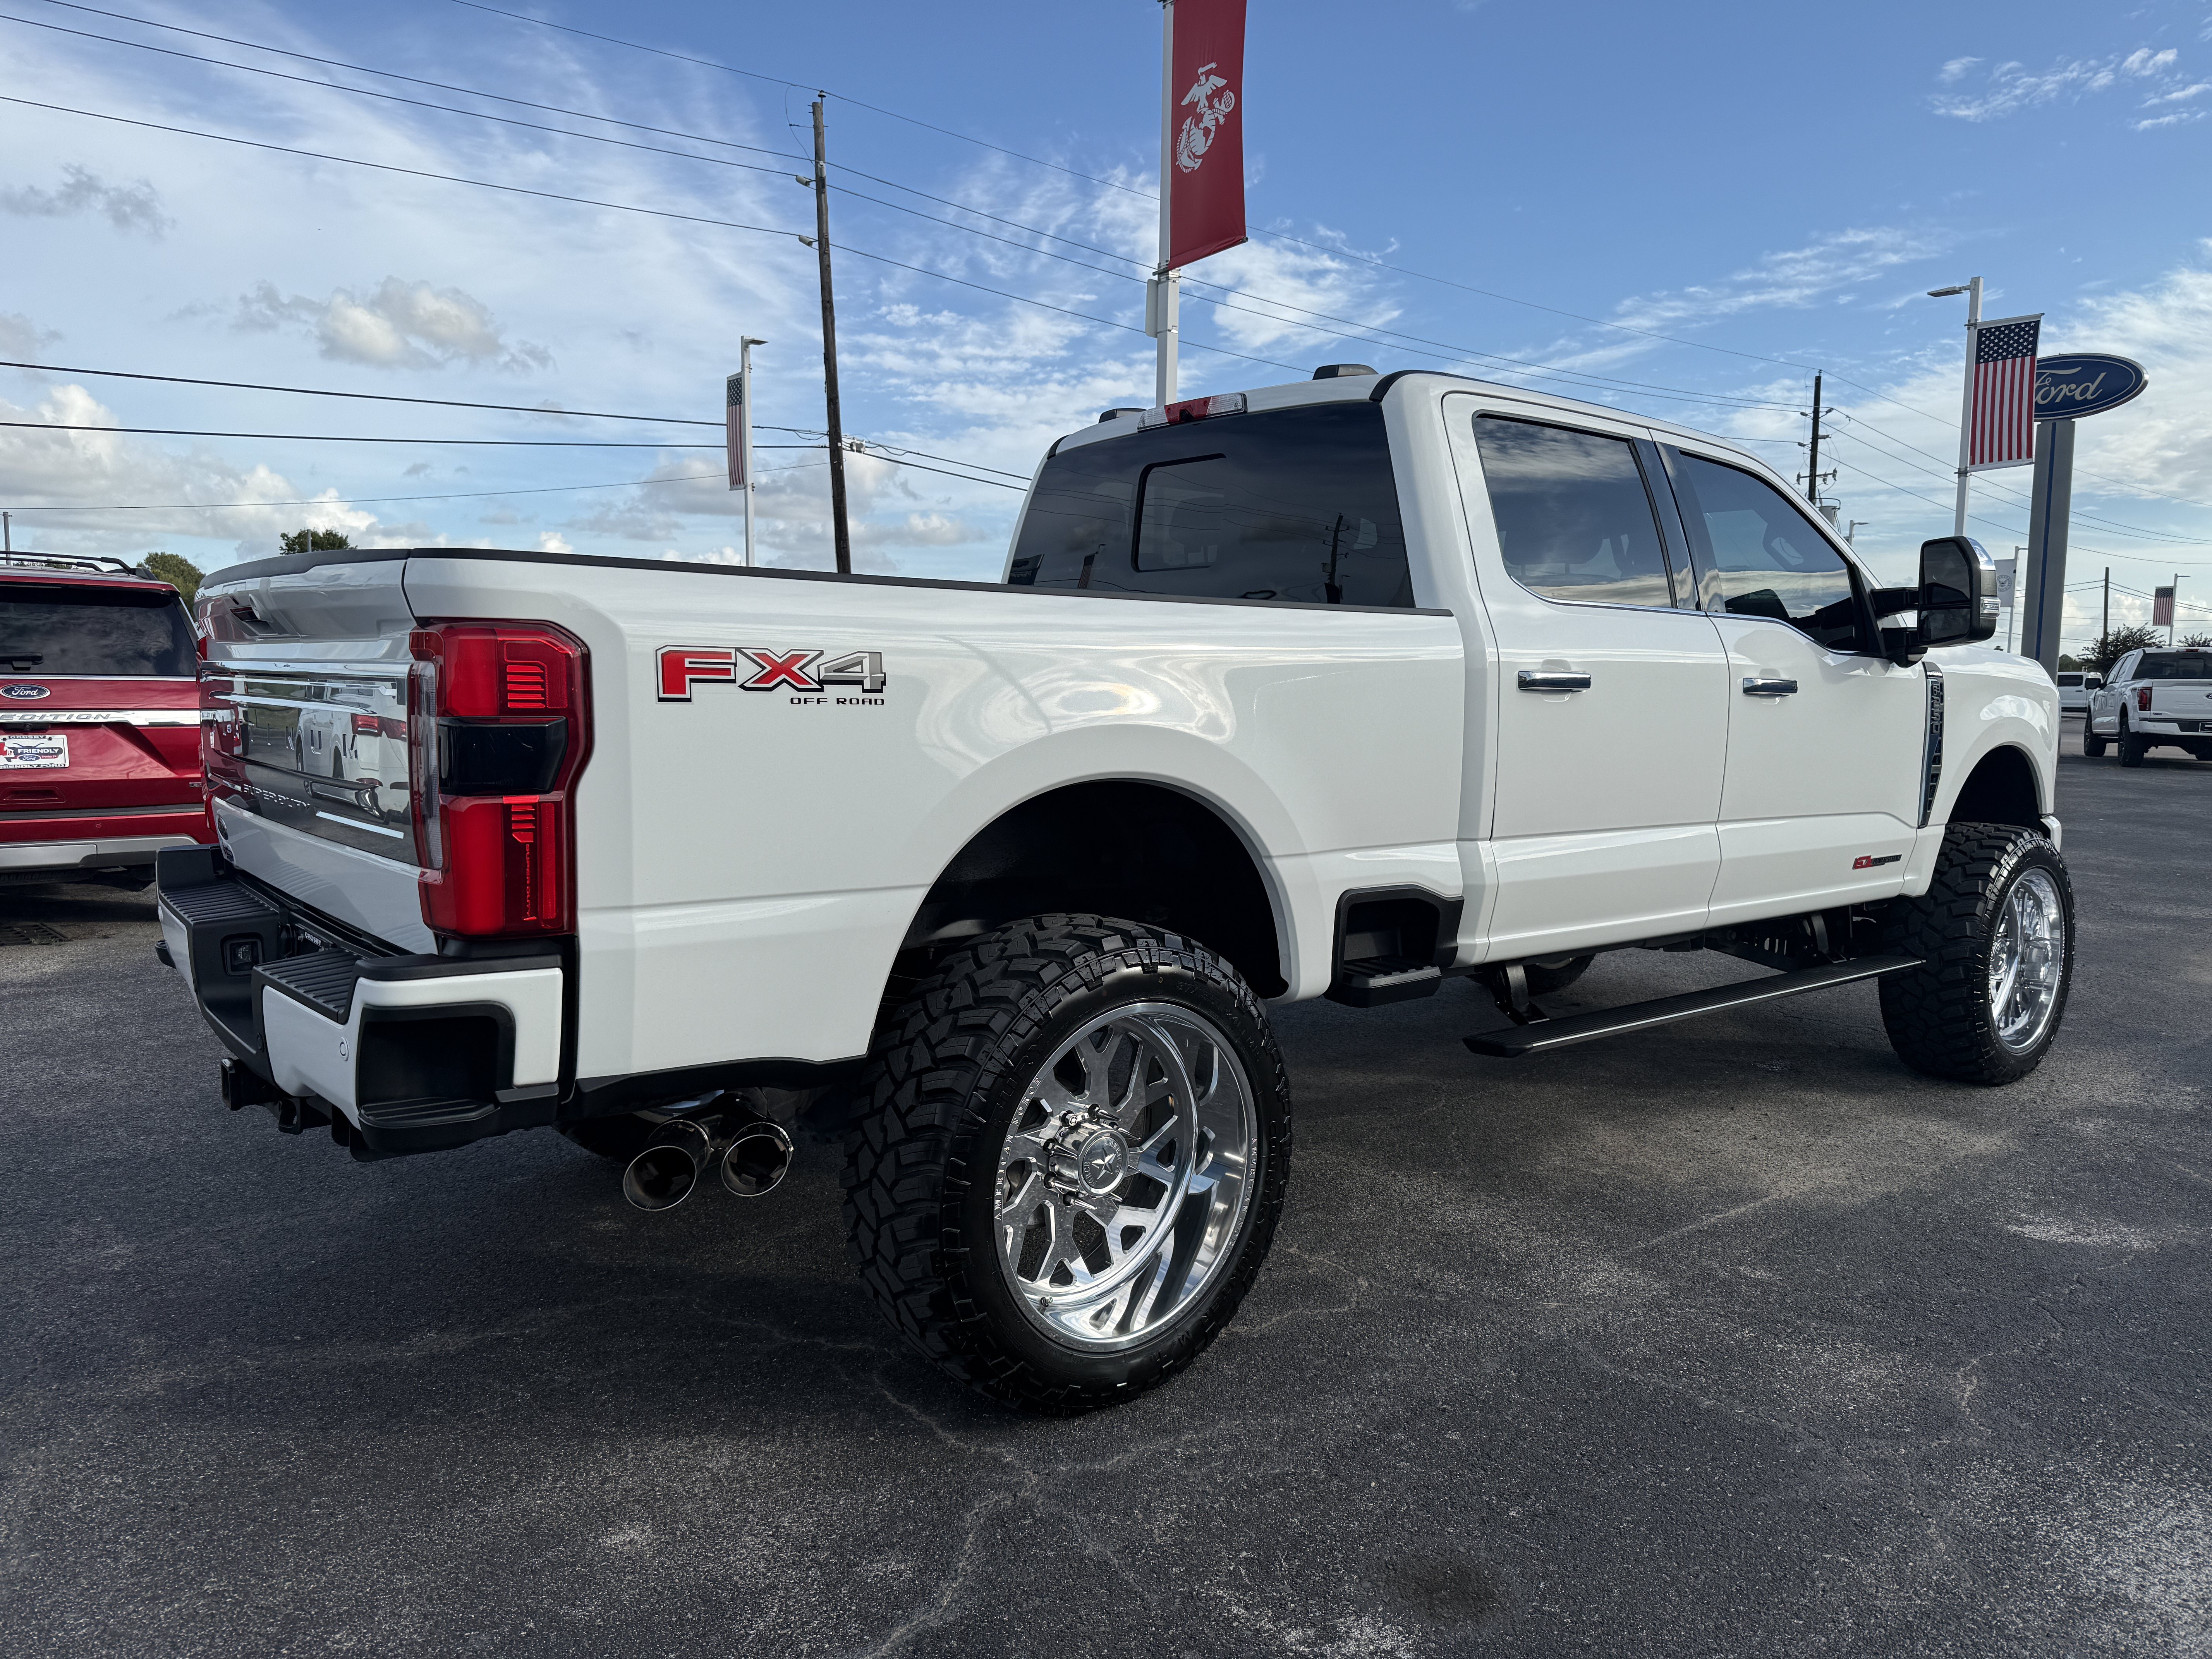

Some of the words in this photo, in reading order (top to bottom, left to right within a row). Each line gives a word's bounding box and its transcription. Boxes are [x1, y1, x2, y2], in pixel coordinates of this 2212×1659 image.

[656, 644, 886, 702] FX4
[12, 686, 38, 696] Ford
[836, 697, 884, 706] ROAD
[305, 932, 321, 946] CROSBY
[994, 1134, 1014, 1220] AMERICAN
[1011, 1077, 1042, 1127] FORCE
